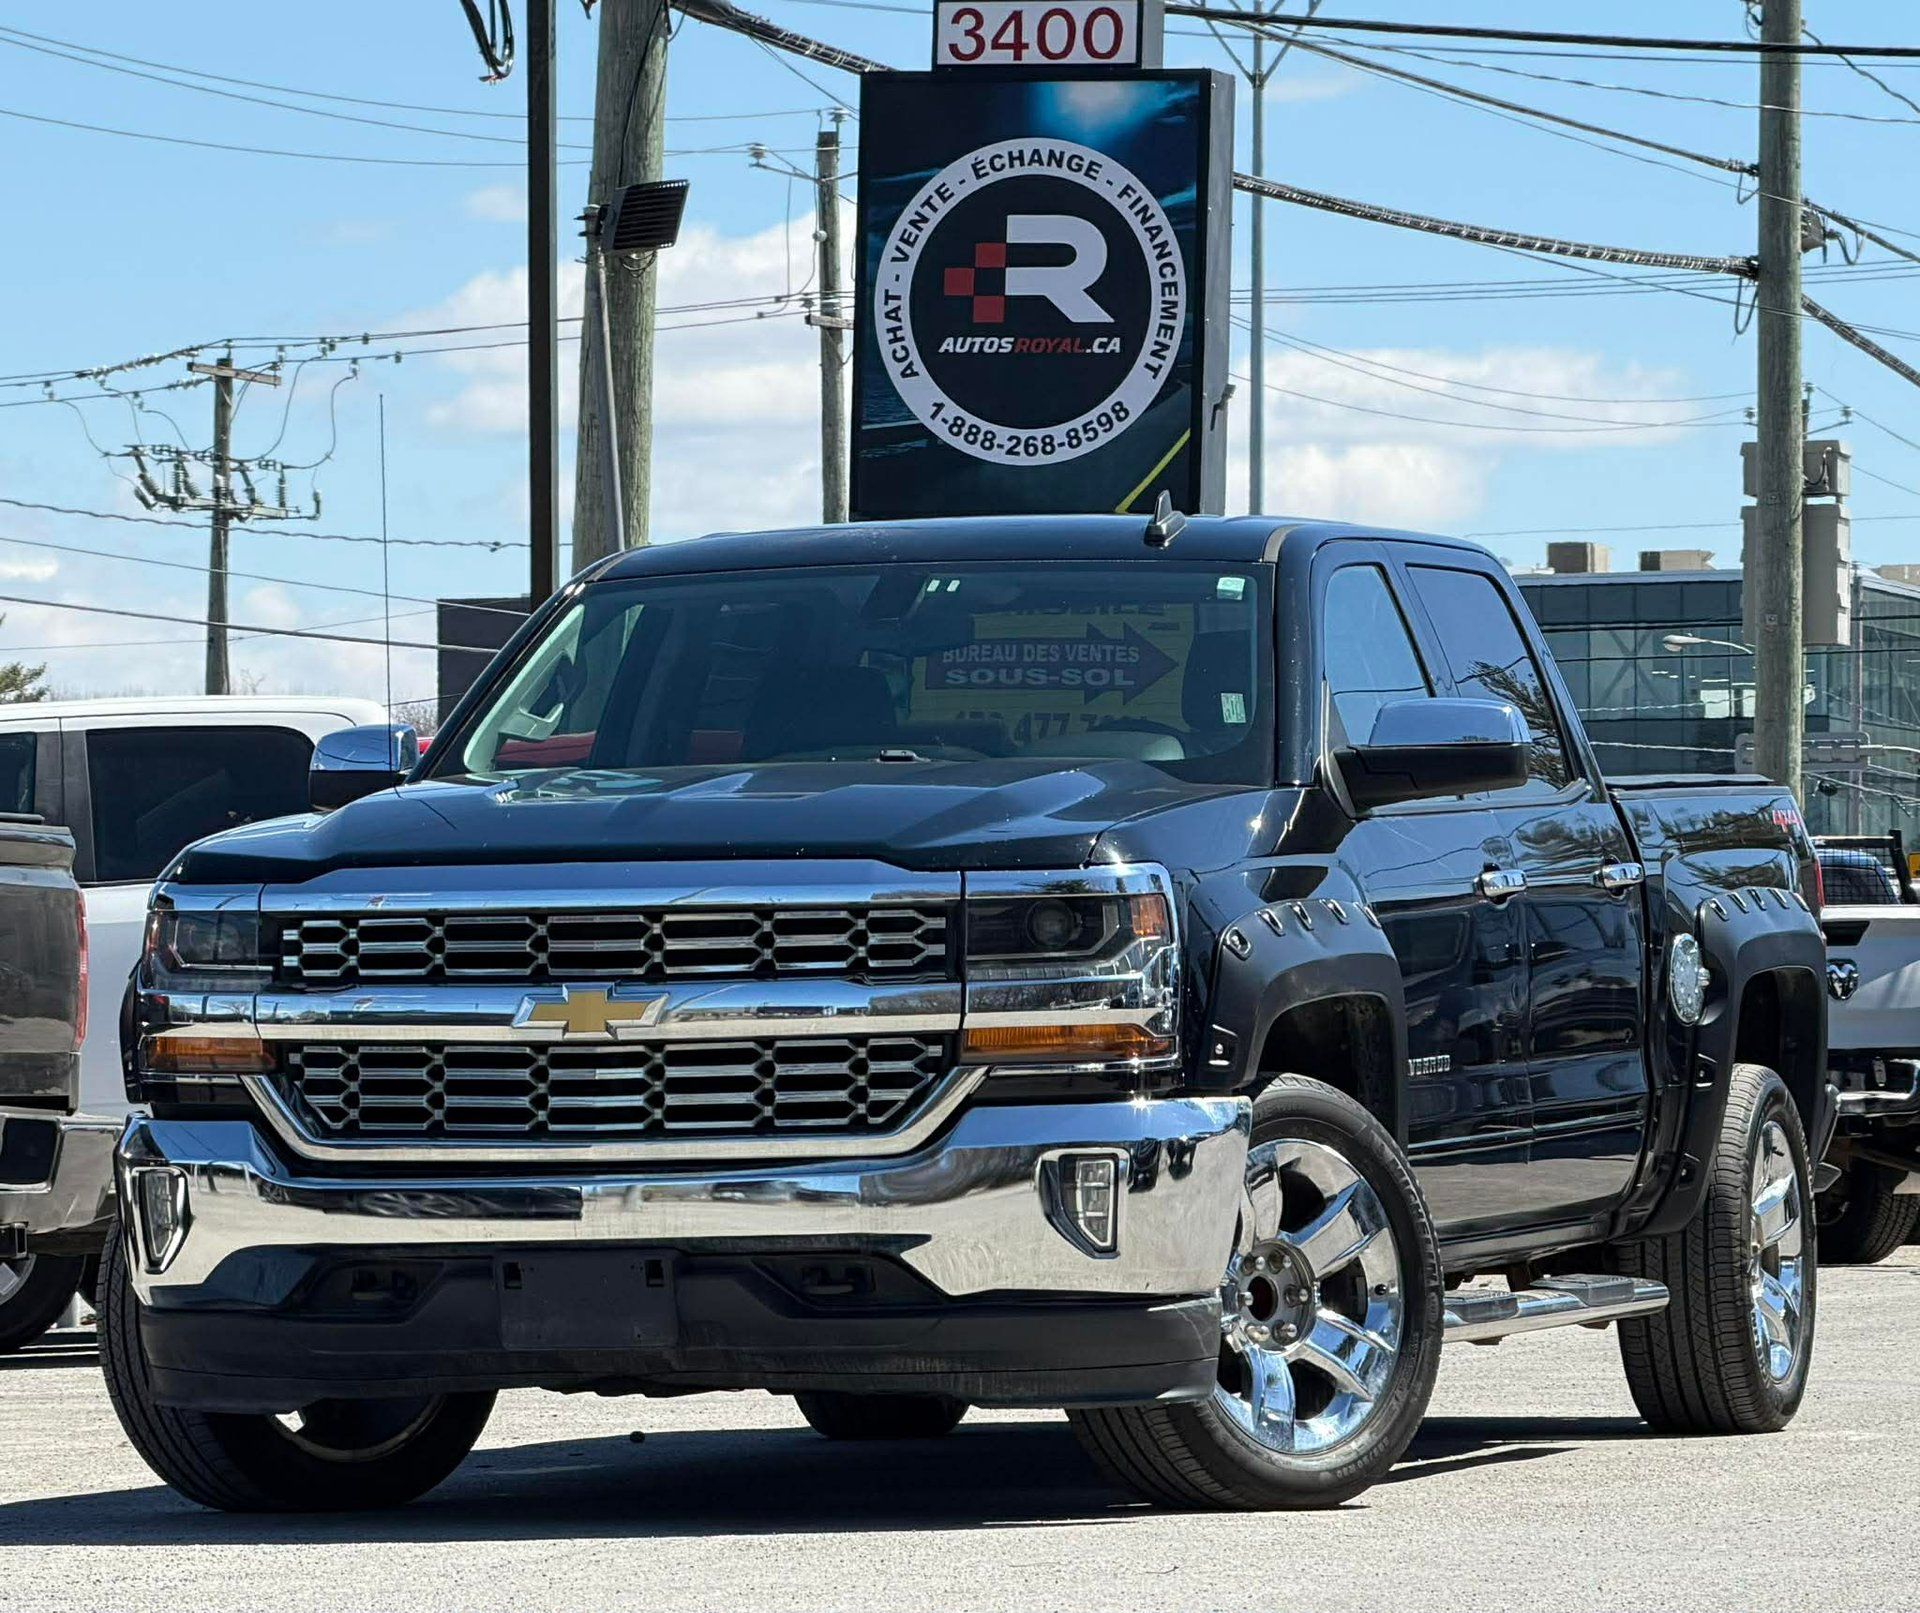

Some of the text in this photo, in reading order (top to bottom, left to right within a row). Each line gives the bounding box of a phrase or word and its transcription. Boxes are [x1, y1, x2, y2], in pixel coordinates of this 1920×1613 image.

[948, 7, 1124, 62] 3400
[970, 148, 1103, 181] ÉCHANGE
[890, 182, 955, 264] VENTE
[1005, 214, 1115, 323] R
[1116, 183, 1179, 380] FINANCEMENT
[883, 289, 920, 379] ACHAT
[938, 337, 1121, 354] AUTOSROYAL.CA
[929, 401, 1130, 457] 1-888-268-8598
[942, 644, 1140, 663] BUREAU DES VENTES
[945, 668, 1135, 686] SOUS-SOL
